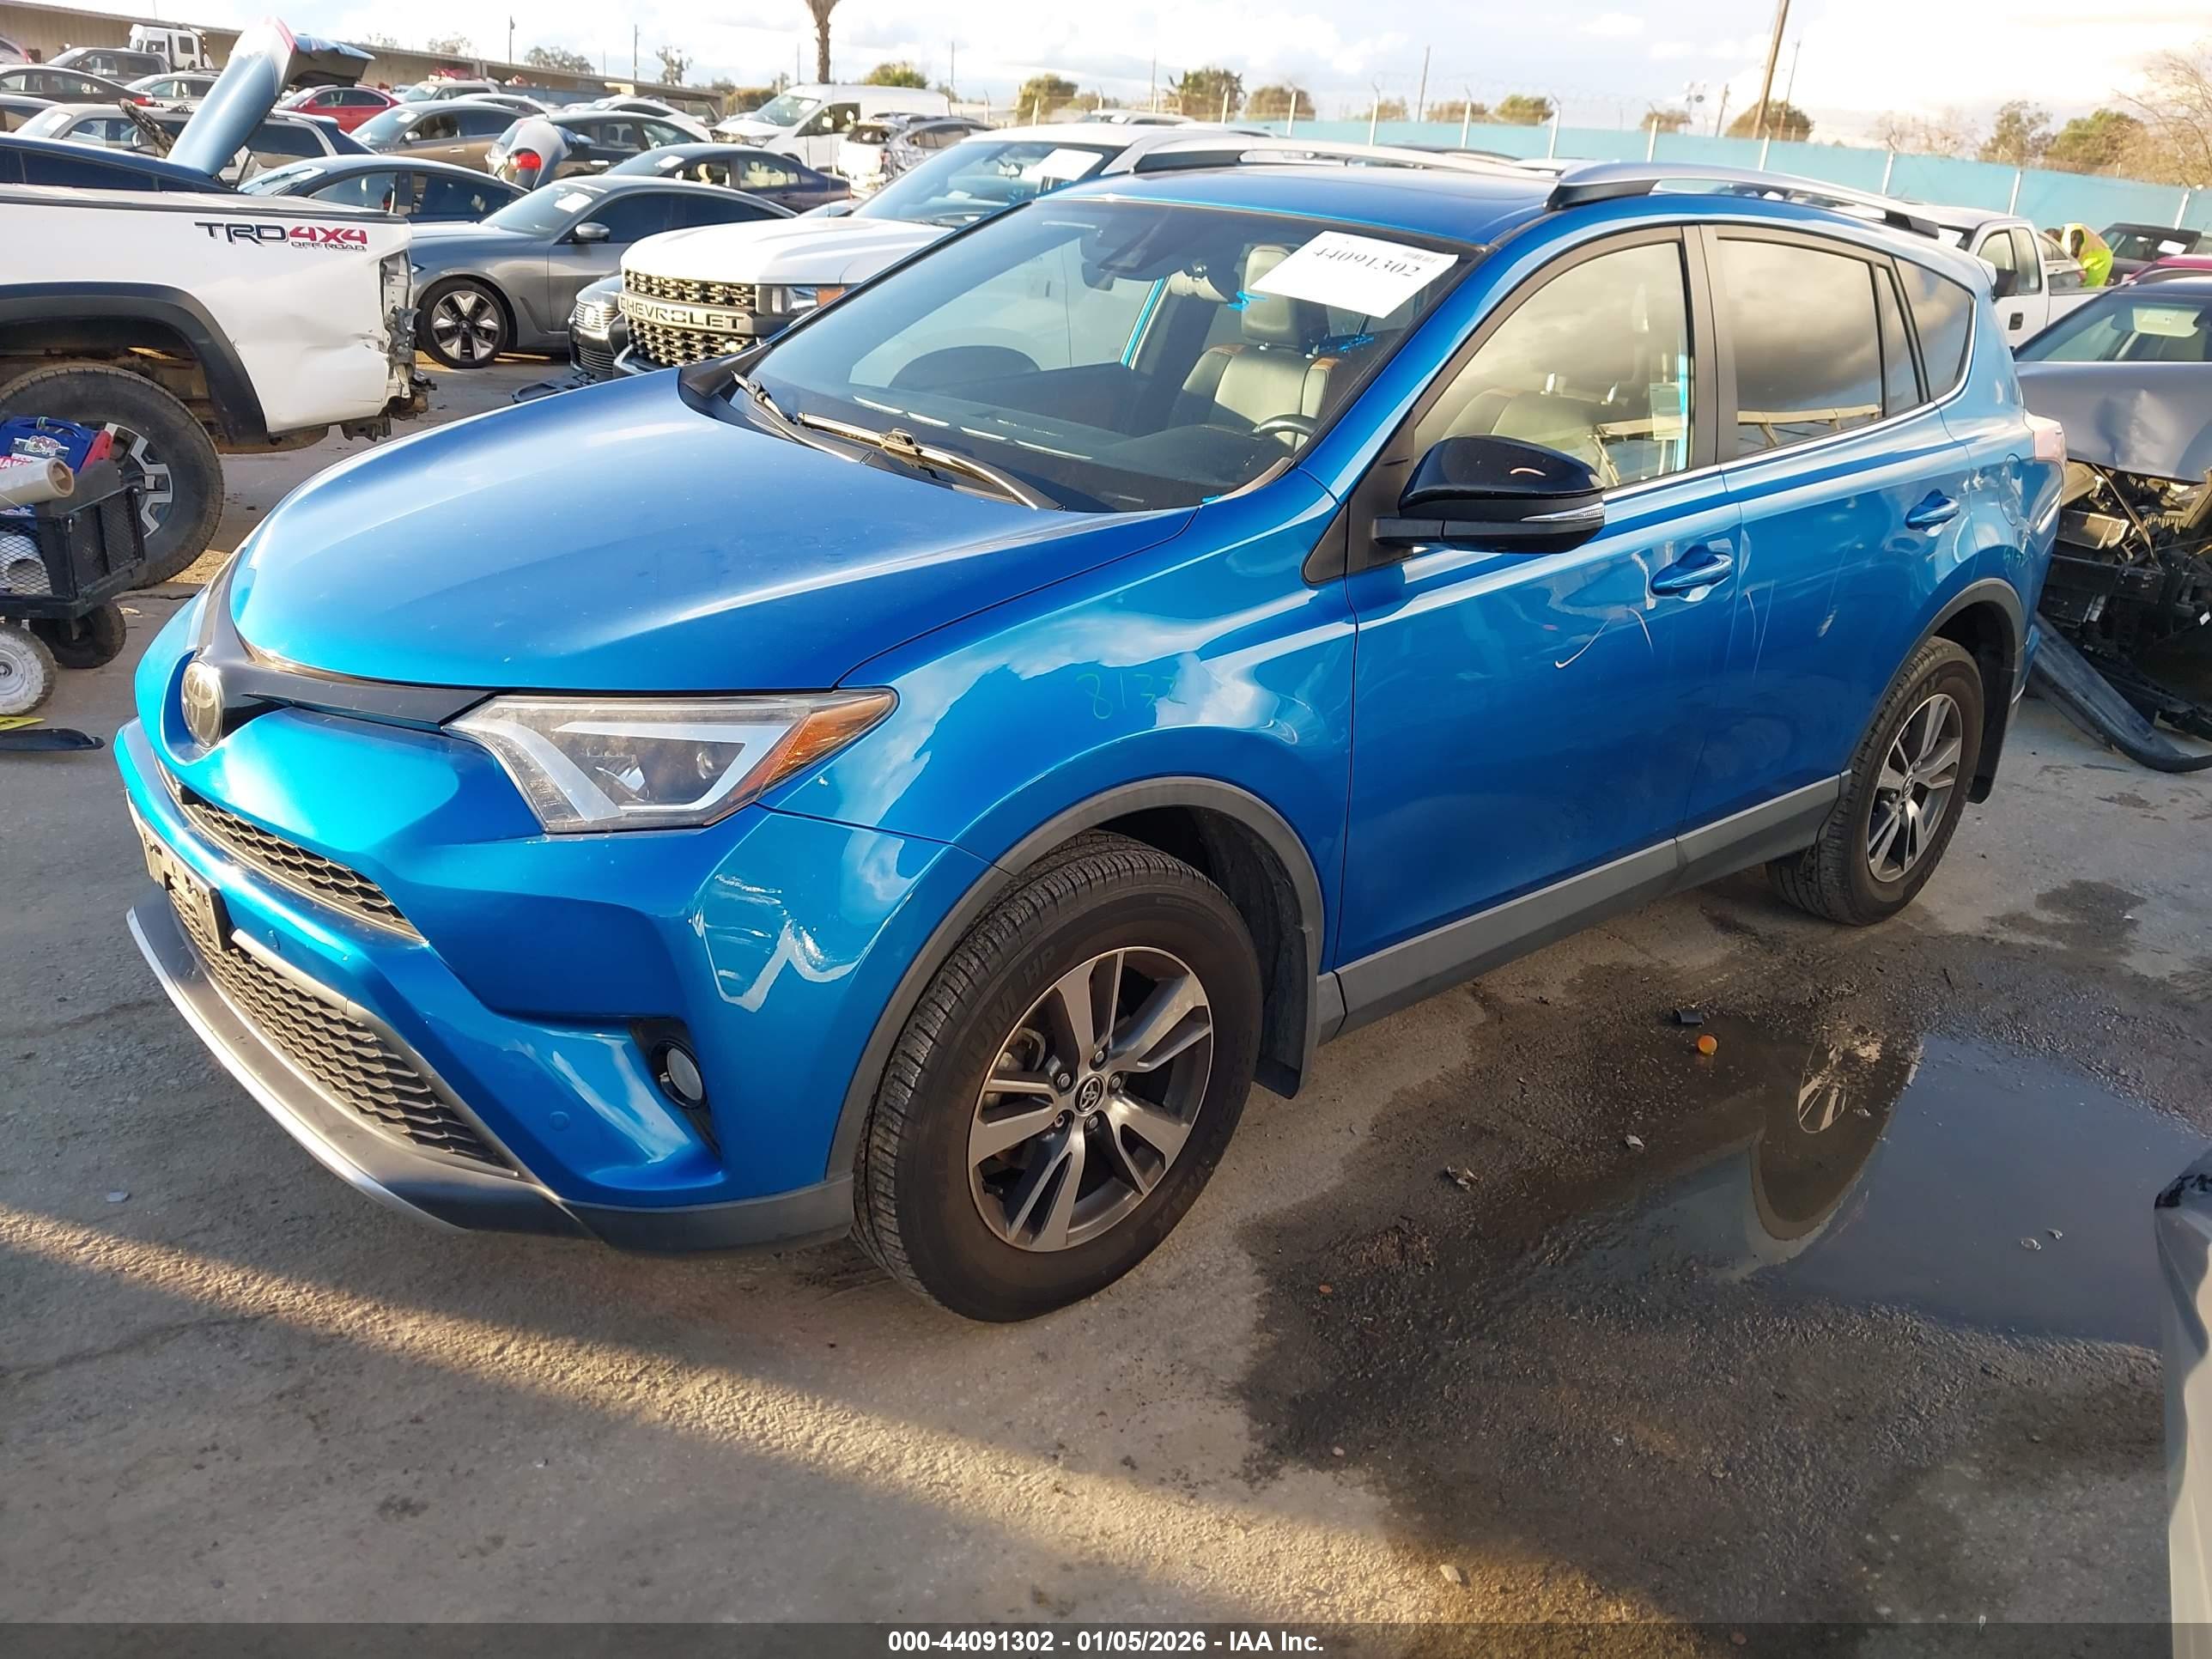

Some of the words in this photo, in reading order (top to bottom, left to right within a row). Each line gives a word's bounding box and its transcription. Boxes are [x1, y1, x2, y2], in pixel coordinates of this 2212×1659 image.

[194, 222, 288, 246] TRD
[289, 226, 368, 244] 4X4
[291, 241, 323, 250] OFF
[325, 242, 368, 252] ROAD
[619, 295, 744, 330] CHEVROLET
